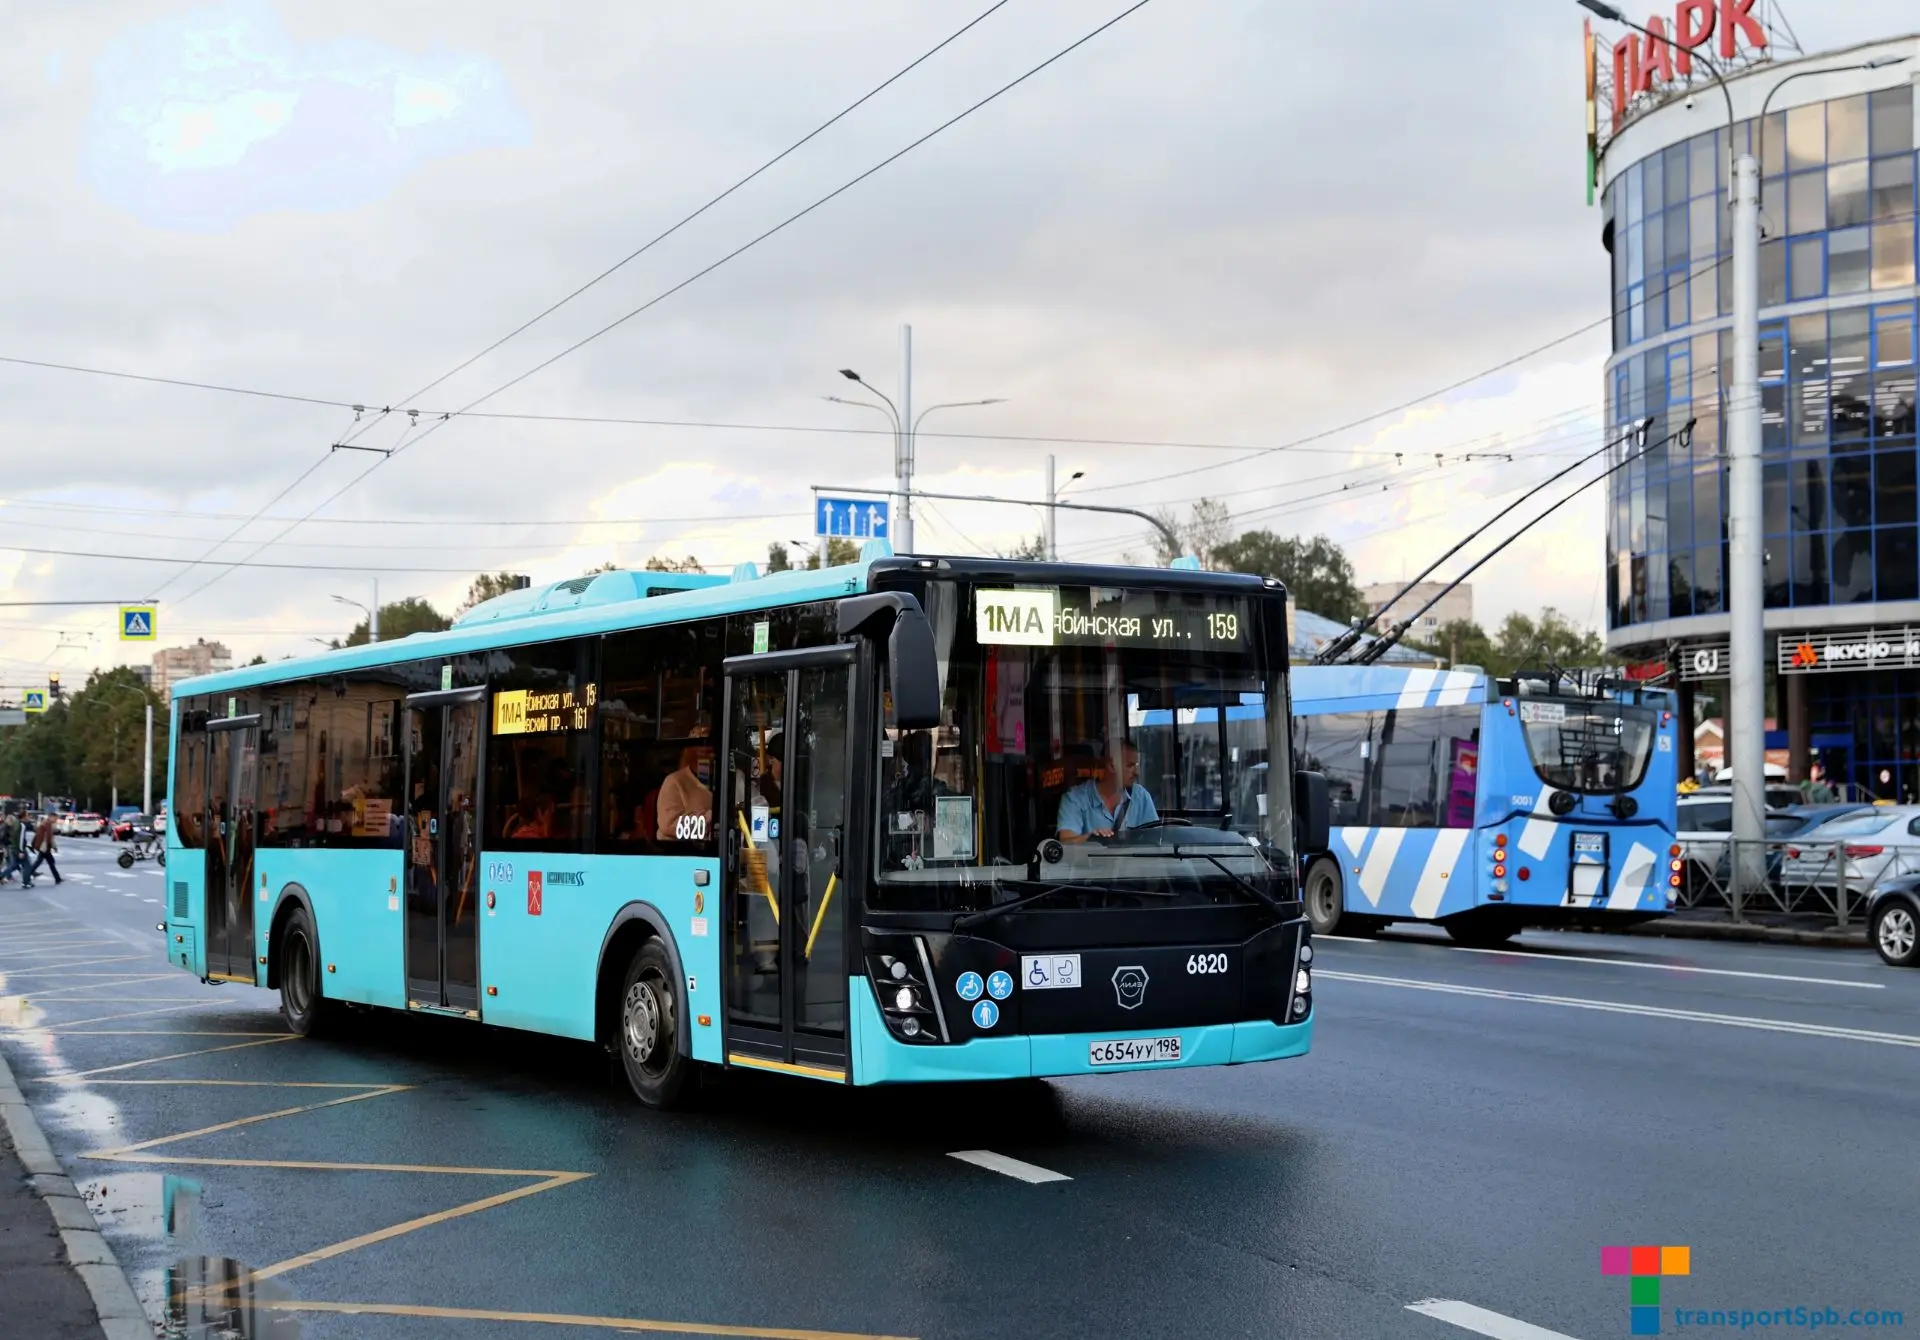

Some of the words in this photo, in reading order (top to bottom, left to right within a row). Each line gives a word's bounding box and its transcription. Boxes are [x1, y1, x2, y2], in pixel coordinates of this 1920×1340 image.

[1612, 0, 1768, 134] ПАРК
[983, 605, 1044, 633] 1МА
[1207, 613, 1237, 639] 159
[1694, 649, 1718, 673] GJ
[585, 683, 597, 707] 15
[501, 702, 523, 725] 1МА
[574, 707, 588, 730] 161
[676, 815, 706, 840] 6820
[1186, 953, 1228, 975] 6820
[1157, 1039, 1177, 1053] 198
